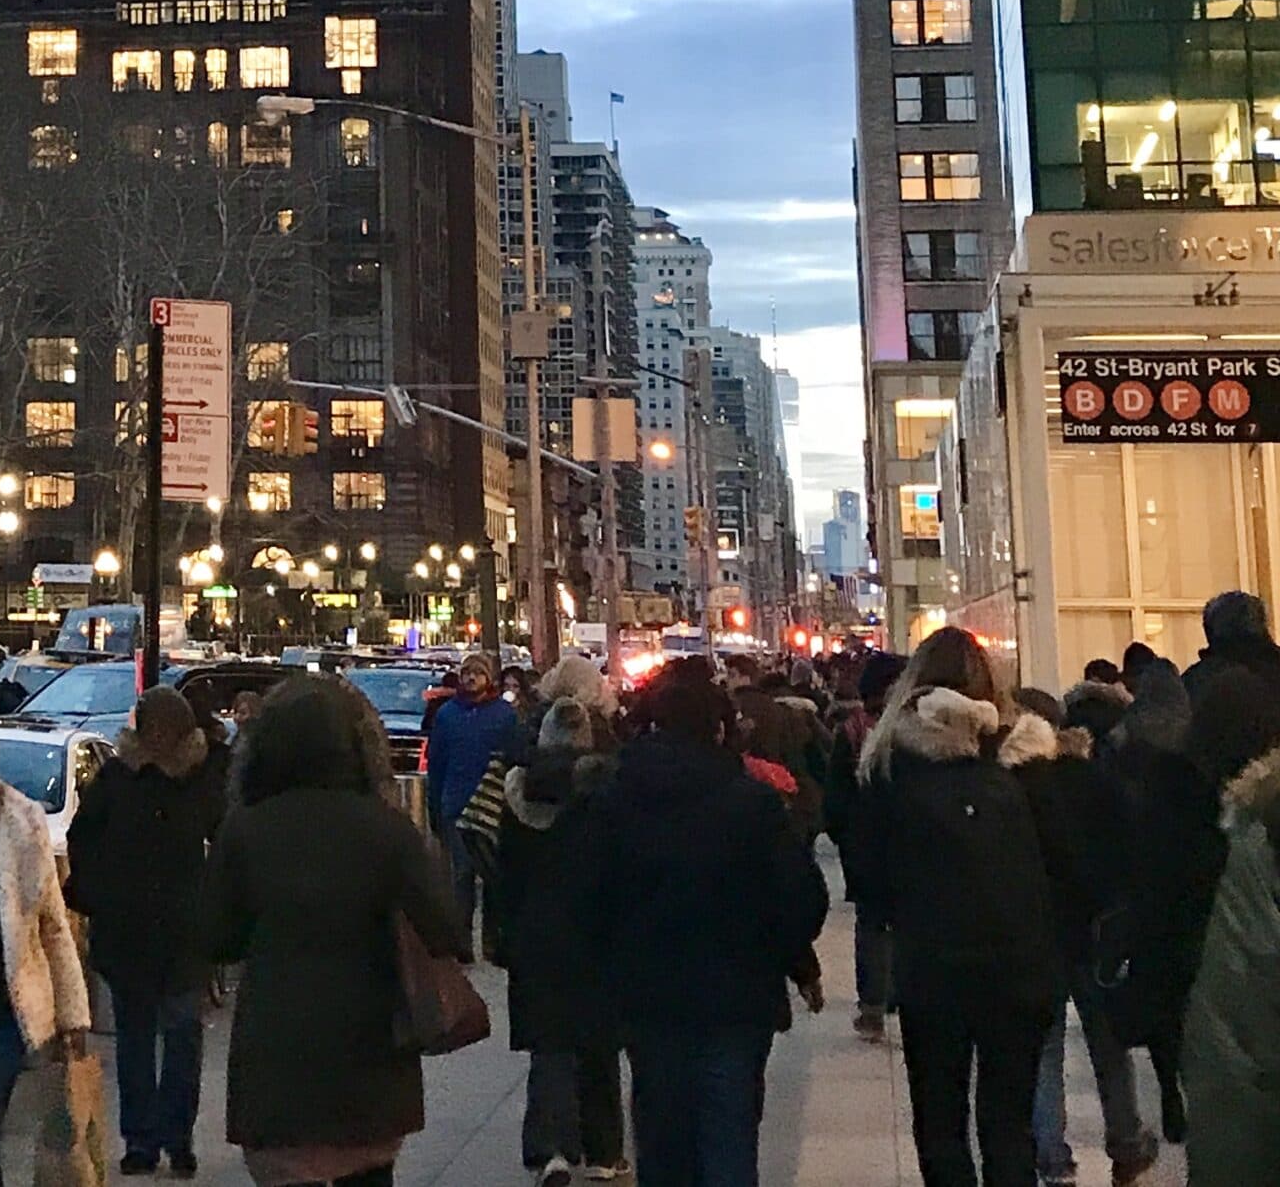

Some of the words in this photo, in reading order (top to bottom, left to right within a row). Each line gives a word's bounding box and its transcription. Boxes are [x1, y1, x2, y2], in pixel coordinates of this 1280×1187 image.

[155, 303, 167, 324] 3
[163, 334, 214, 344] OMMERCIAL
[164, 346, 197, 356] EHICLES
[200, 347, 222, 358] ONLY
[1060, 358, 1087, 377] 42
[1094, 358, 1199, 380] St-Bryant
[1207, 358, 1257, 376] Park
[1076, 389, 1095, 412] B
[1123, 389, 1144, 411] D
[1172, 389, 1189, 412] F
[1217, 389, 1240, 410] M
[1063, 422, 1101, 436] Enter
[1109, 425, 1160, 436] across
[1167, 422, 1187, 436] 42
[1190, 422, 1207, 436] St
[1214, 422, 1236, 436] for
[1248, 423, 1257, 435] 7
